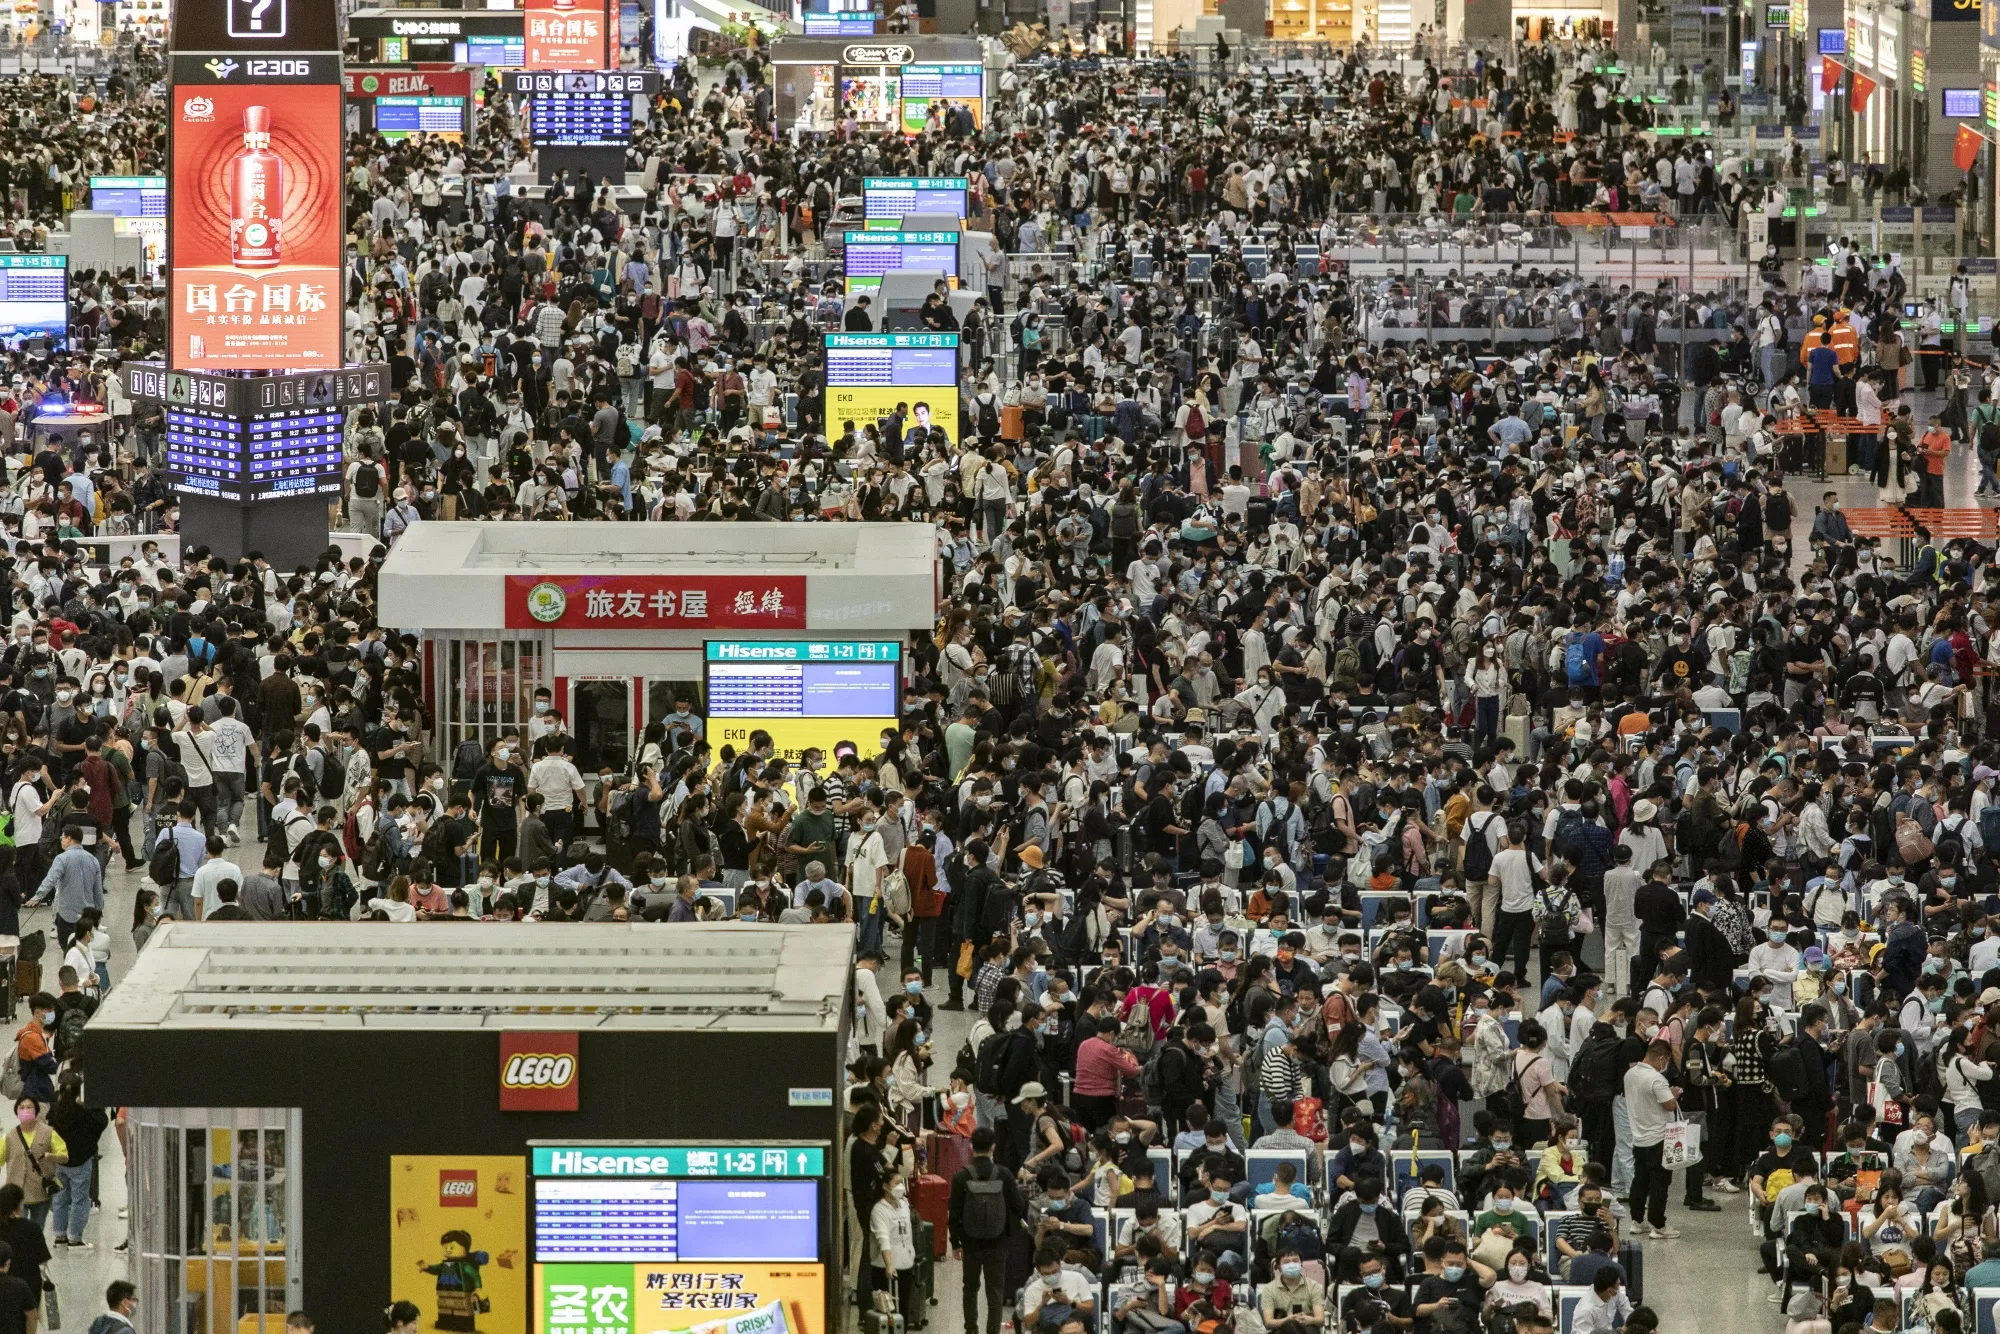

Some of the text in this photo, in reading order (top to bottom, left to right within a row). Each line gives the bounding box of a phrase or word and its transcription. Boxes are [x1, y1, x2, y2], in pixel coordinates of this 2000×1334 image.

[728, 12, 789, 23] 喜迎二十大
[246, 60, 310, 76] 12306
[389, 76, 425, 93] RELAY
[382, 97, 418, 105] Hisense
[870, 179, 913, 188] Hisense
[852, 233, 898, 242] Hisense
[918, 234, 932, 242] 1-15
[26, 258, 39, 266] 1-15
[186, 283, 327, 313] 国台国标
[833, 336, 888, 345] Hisense
[912, 336, 926, 344] 1-17
[838, 394, 852, 402] EKO
[838, 407, 877, 415] 智能垃圾桶
[585, 589, 708, 618] 旅友书屋
[733, 586, 784, 618] 經緯
[719, 644, 797, 658] Hisense
[833, 645, 854, 657] 1-21
[724, 729, 746, 740] EKO
[504, 1056, 574, 1086] LEGO
[552, 1151, 669, 1174] Hisense
[724, 1152, 756, 1173] 1-25
[442, 1181, 475, 1196] LEGO
[646, 1273, 744, 1290] 炸鸡行家
[550, 1285, 629, 1324] 圣农
[661, 1292, 759, 1309] 圣农到家
[736, 1311, 775, 1334] CRISPY
